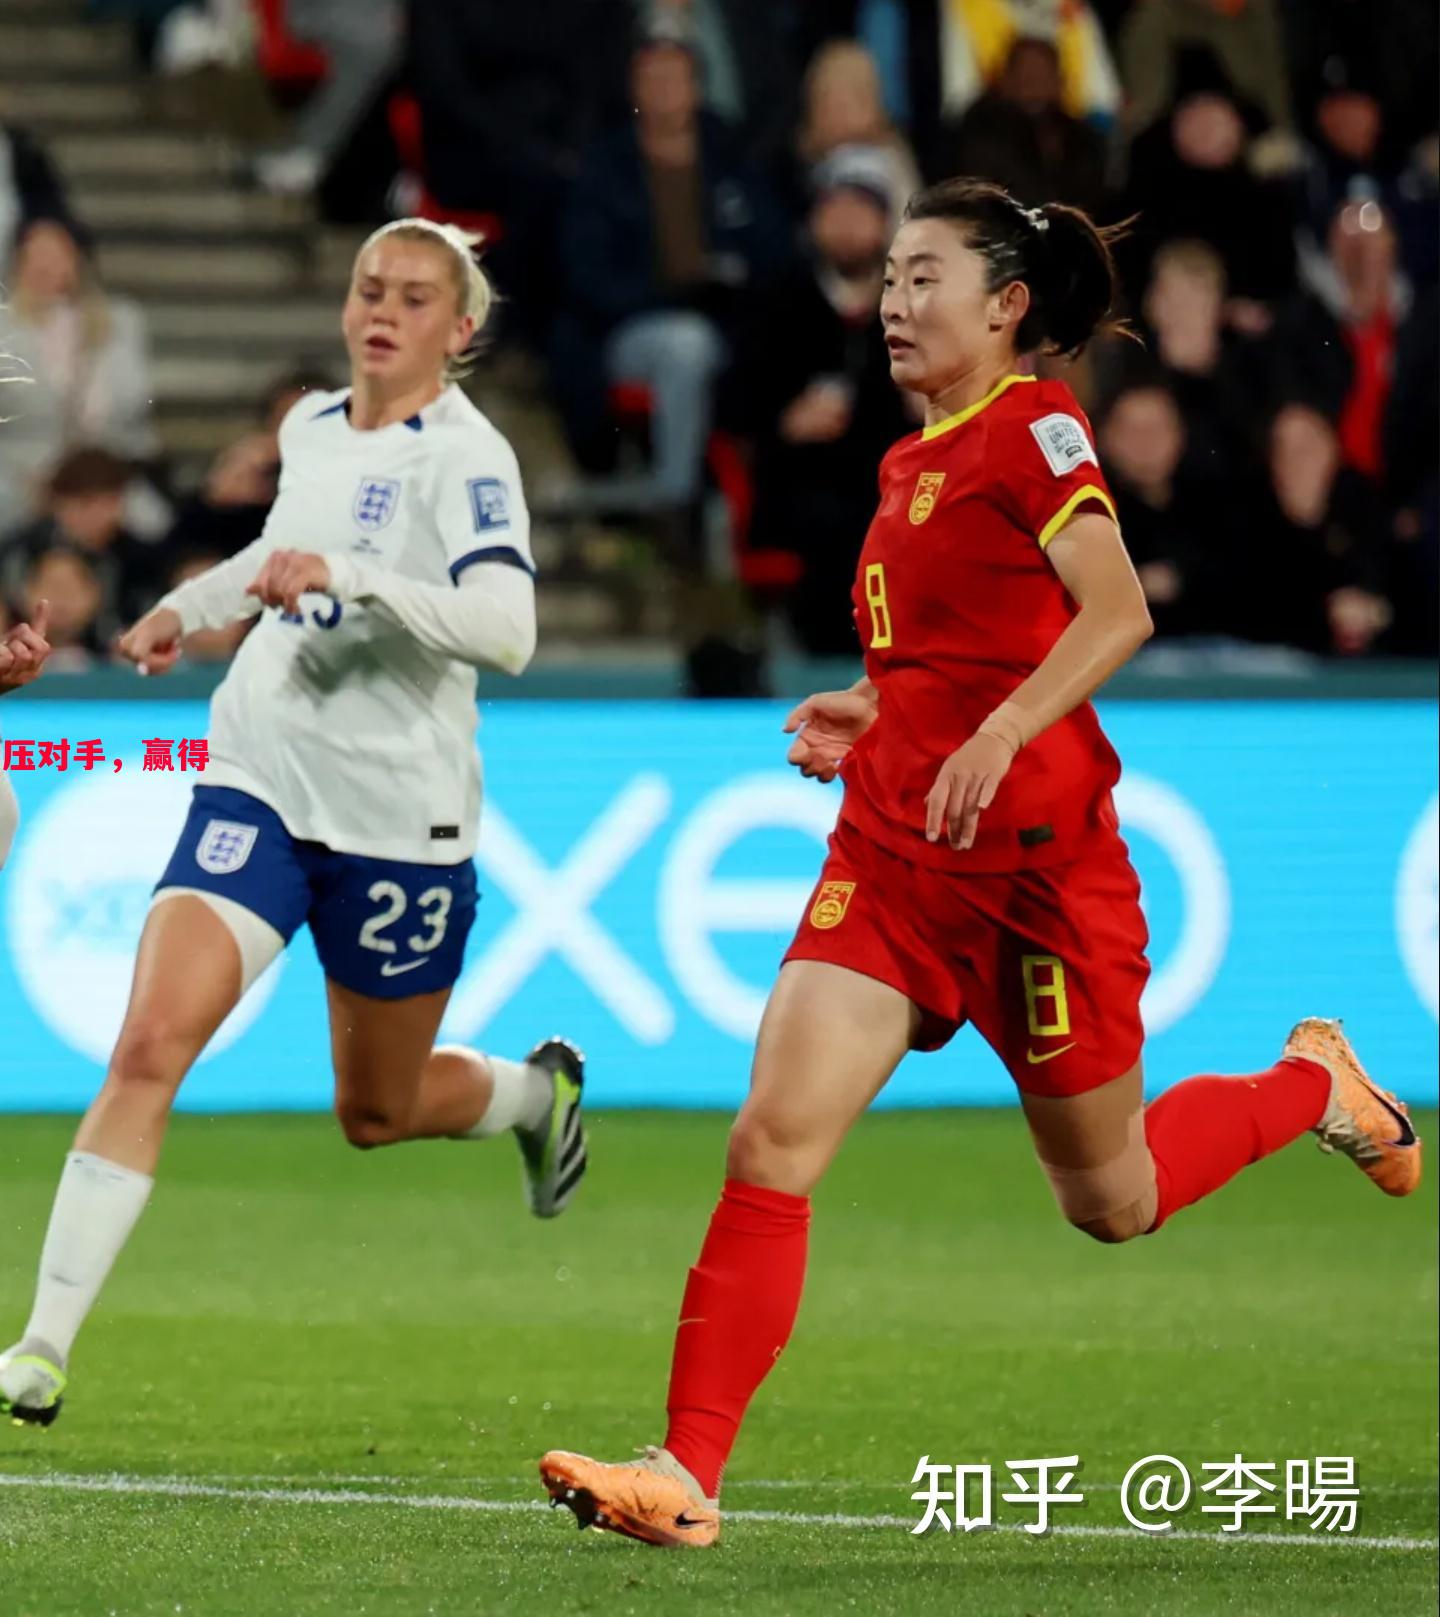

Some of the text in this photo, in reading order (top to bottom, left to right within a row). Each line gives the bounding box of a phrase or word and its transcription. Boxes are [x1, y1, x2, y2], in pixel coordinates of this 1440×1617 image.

[865, 562, 892, 648] 8
[358, 879, 453, 955] 23
[1022, 954, 1071, 1037] 8
